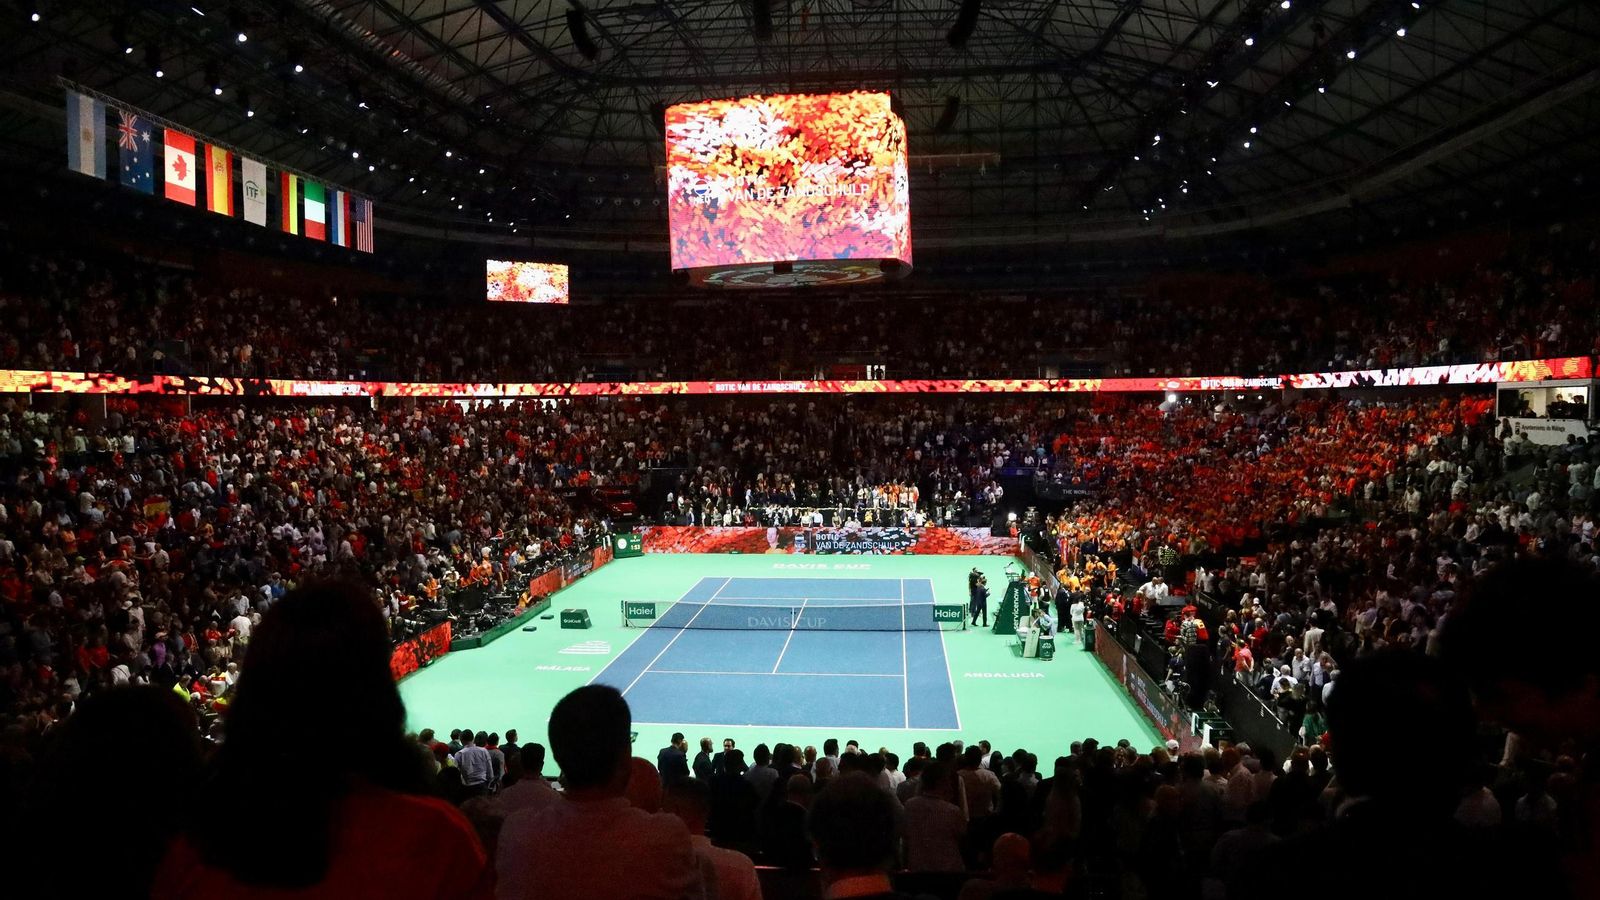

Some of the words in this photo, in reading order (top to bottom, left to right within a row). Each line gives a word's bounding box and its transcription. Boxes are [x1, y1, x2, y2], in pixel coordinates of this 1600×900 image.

[246, 185, 258, 198] ITF
[729, 187, 753, 201] VAN
[757, 188, 774, 199] DE
[779, 184, 869, 199] ZANDSCHULP
[715, 383, 736, 391] BOTIC
[737, 383, 750, 391] VAN
[815, 541, 832, 549] VAN
[845, 541, 901, 549] ZANDSCHULP
[628, 606, 654, 615] Haier
[934, 609, 961, 618] Haier
[1012, 587, 1020, 630] servicenow
[747, 616, 791, 628] DAVIS
[797, 616, 827, 628] CUP
